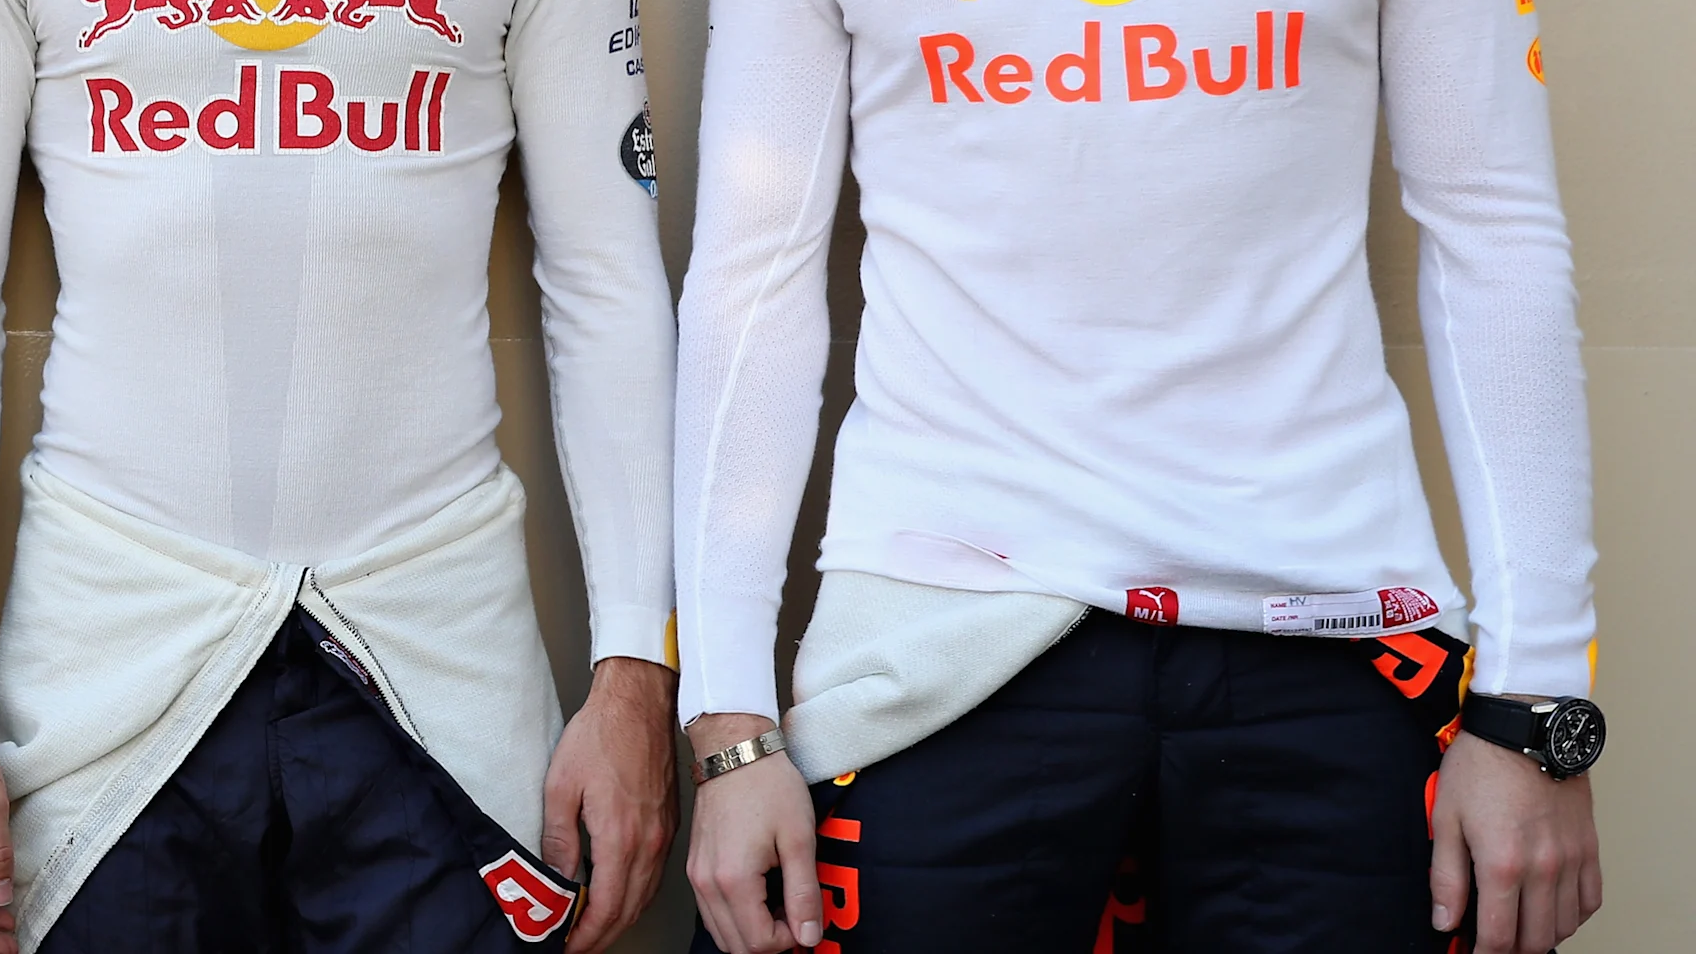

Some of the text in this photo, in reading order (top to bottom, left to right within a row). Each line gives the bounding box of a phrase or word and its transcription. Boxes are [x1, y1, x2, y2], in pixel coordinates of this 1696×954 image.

[918, 10, 1305, 105] Red Bull
[85, 65, 452, 153] Red Bull
[1134, 606, 1168, 623] M/L
